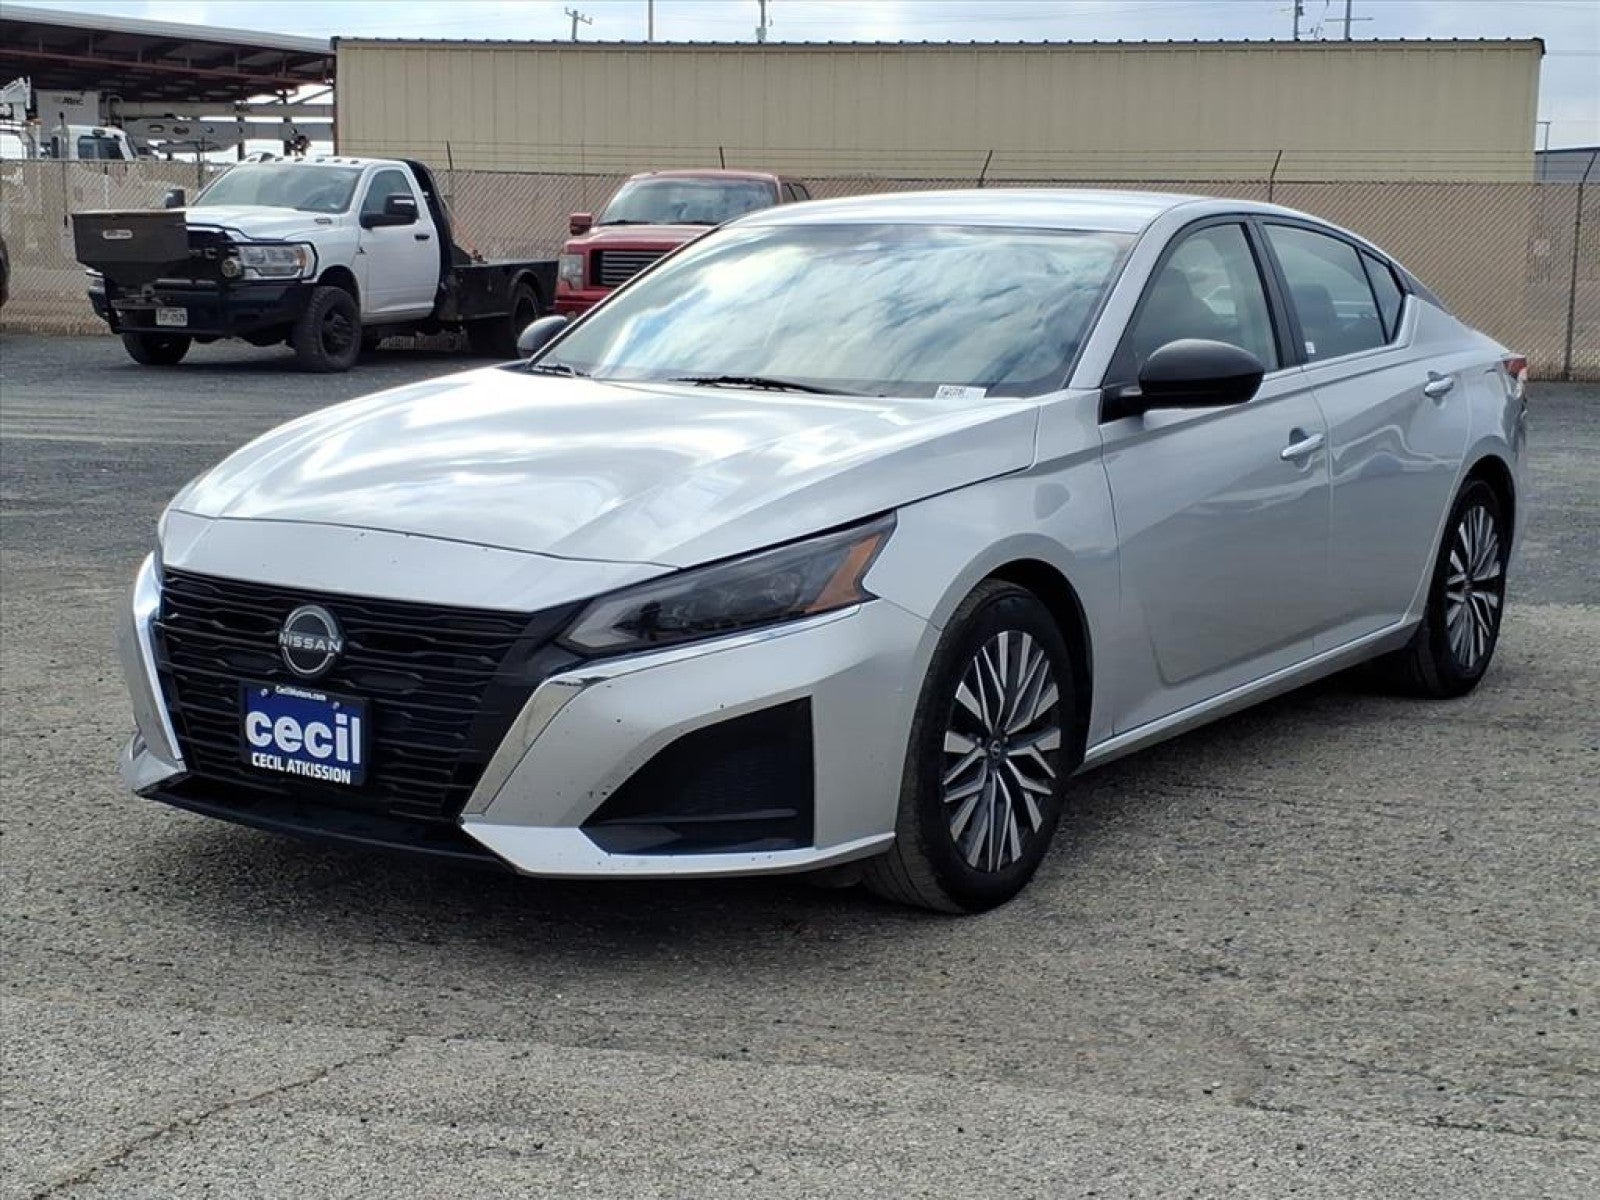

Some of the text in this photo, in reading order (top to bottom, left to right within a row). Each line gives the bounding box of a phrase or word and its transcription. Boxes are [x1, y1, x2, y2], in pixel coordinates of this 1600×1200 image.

[279, 632, 342, 652] NISSAN
[246, 710, 361, 765] cecil
[252, 752, 351, 785] CECIL ATKISSION
